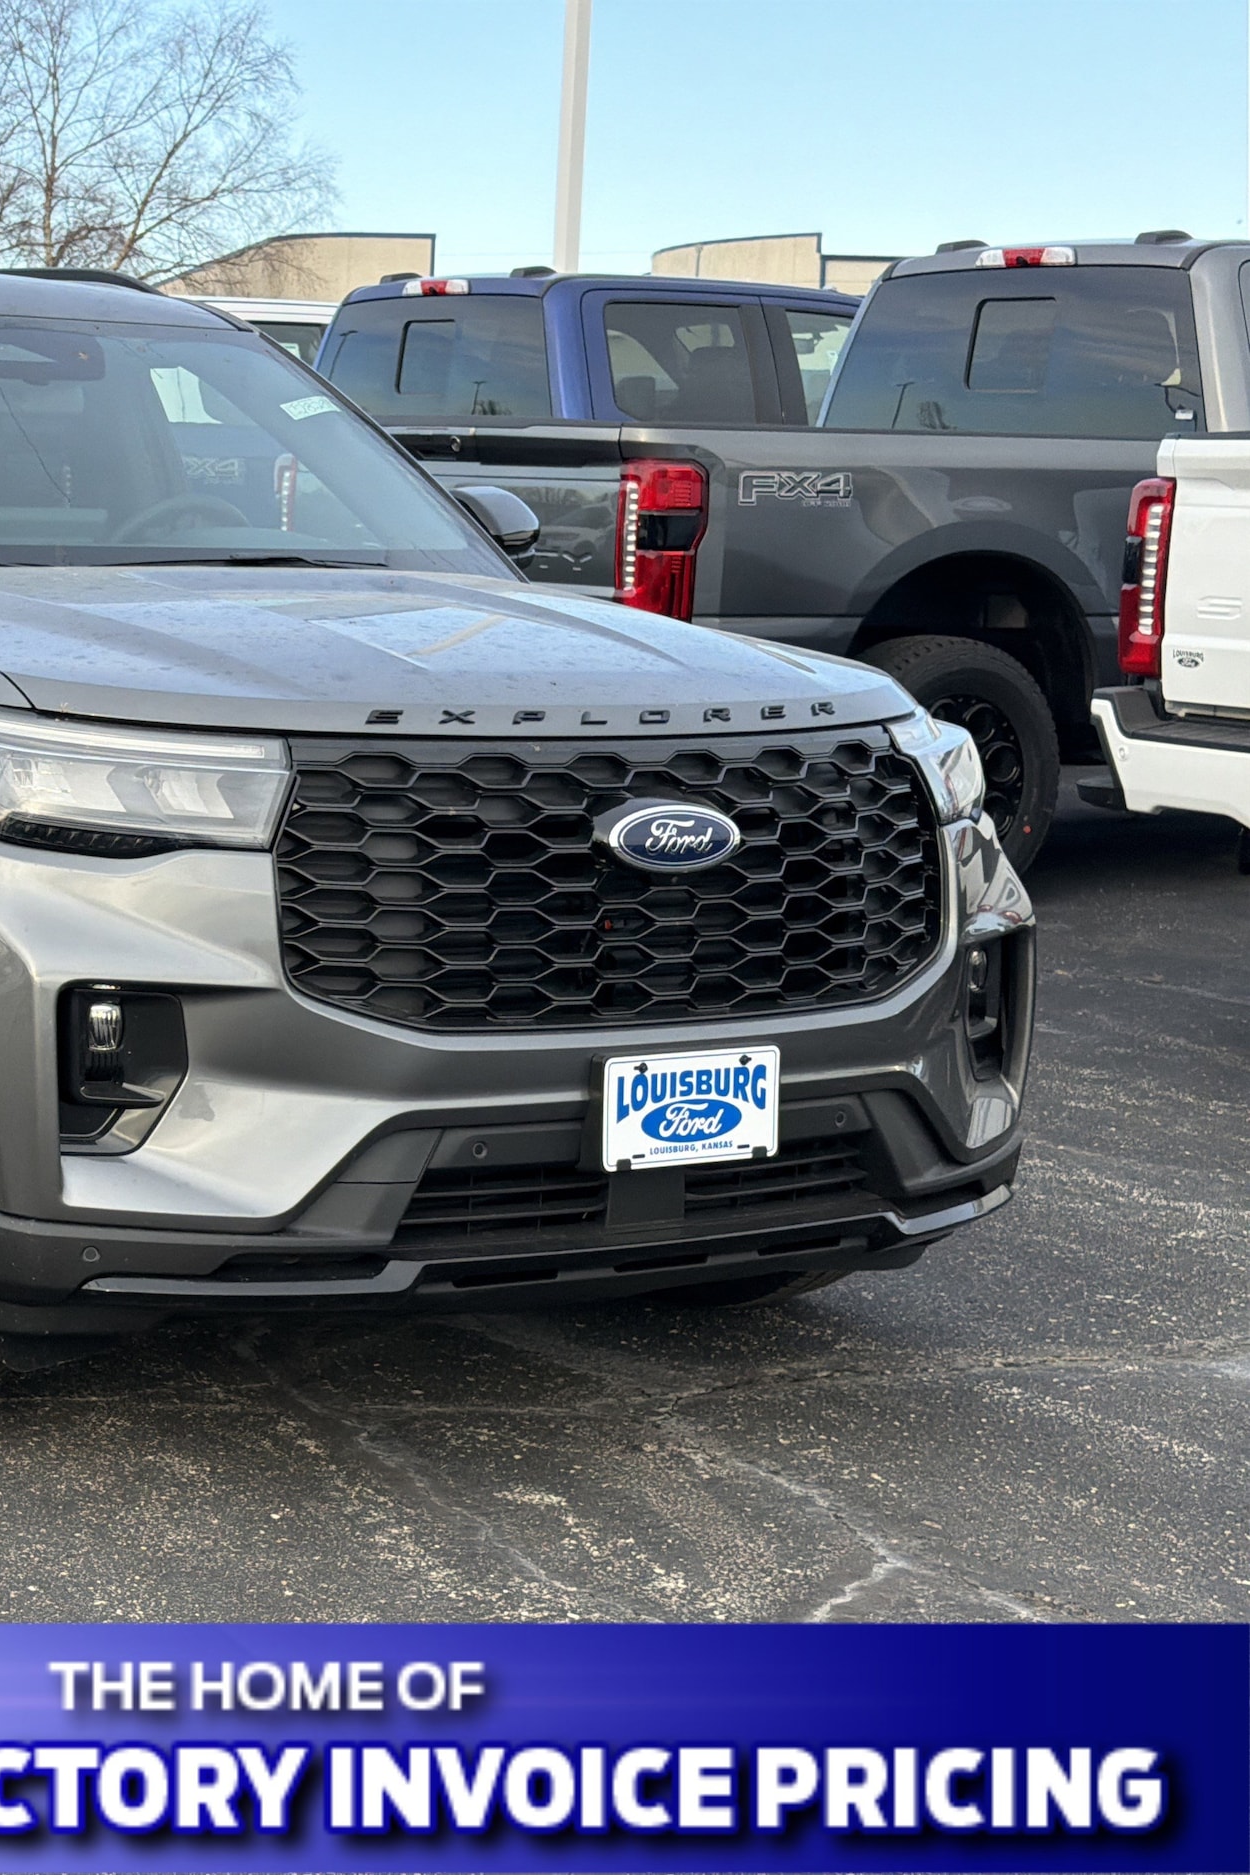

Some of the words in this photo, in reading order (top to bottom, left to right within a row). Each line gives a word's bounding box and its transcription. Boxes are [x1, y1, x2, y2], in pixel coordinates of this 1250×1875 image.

[738, 470, 853, 506] FX4
[364, 701, 837, 726] EXPLORER
[644, 818, 714, 856] Ford
[616, 1064, 767, 1124] LOUISBURG
[658, 1102, 725, 1138] Ford
[649, 1143, 699, 1156] LOUISBURG,
[701, 1140, 734, 1151] KANSAS
